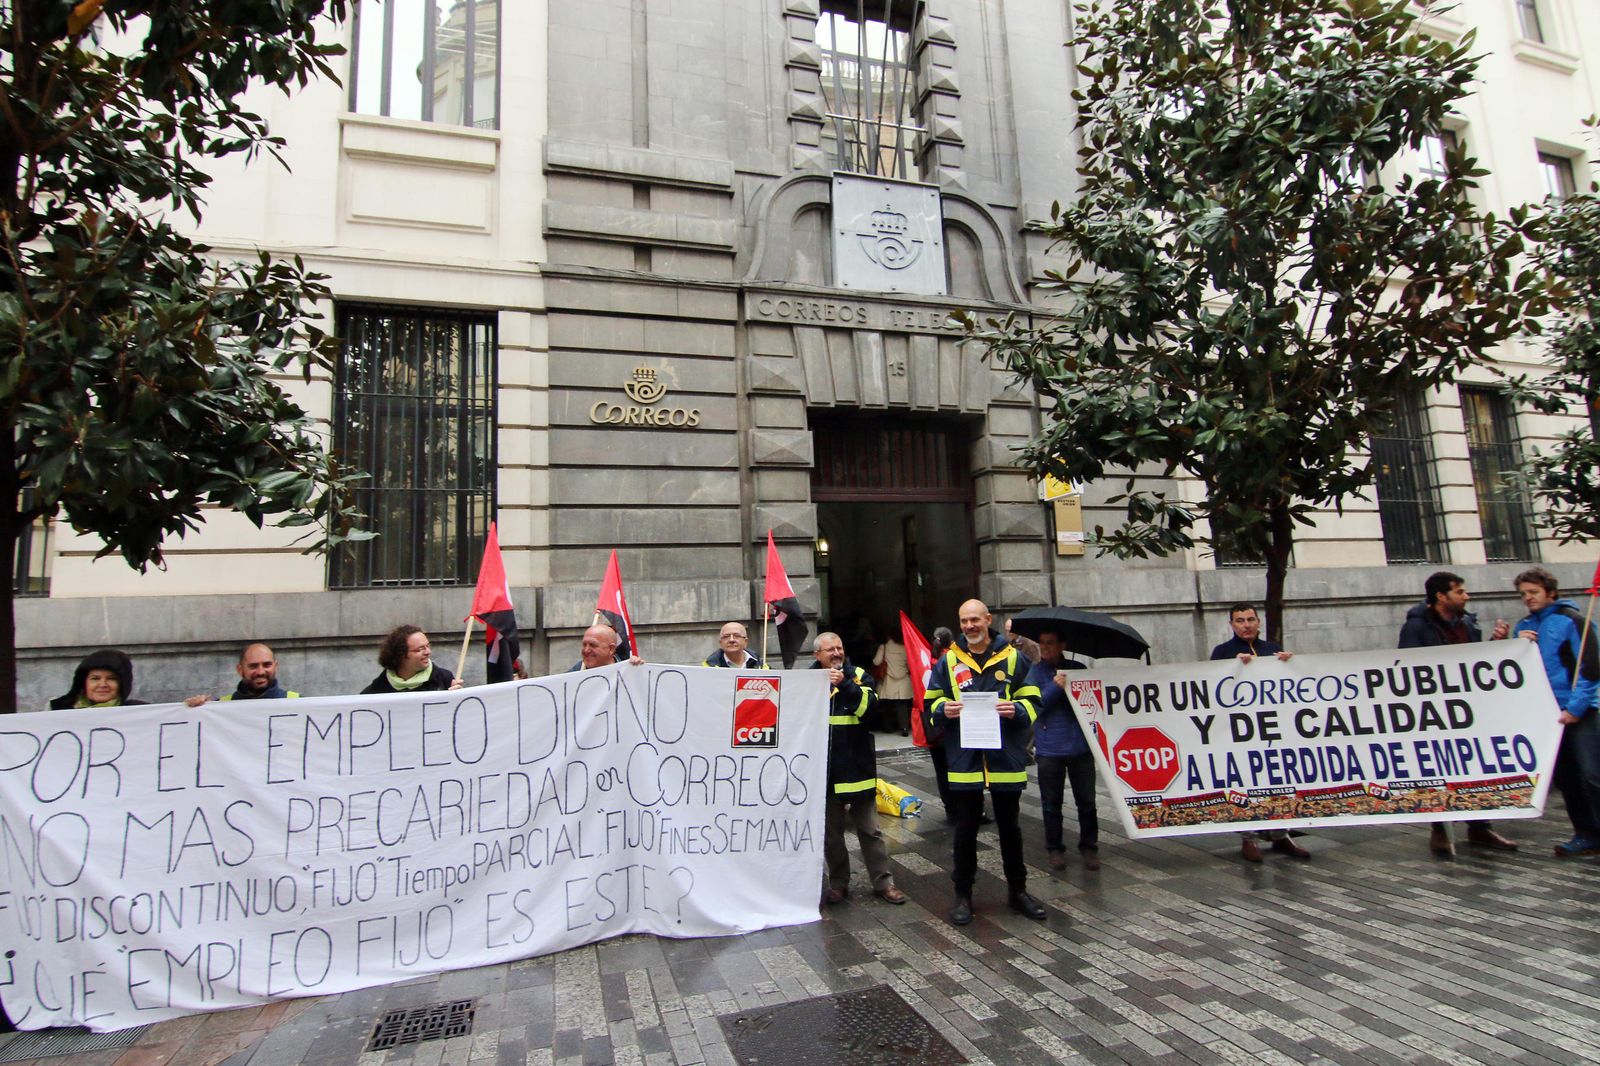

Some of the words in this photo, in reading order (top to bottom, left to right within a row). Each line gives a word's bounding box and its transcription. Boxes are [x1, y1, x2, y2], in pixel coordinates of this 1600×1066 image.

[758, 299, 867, 325] CORREOS
[889, 361, 905, 377] 15
[589, 401, 701, 428] CORREOS
[959, 679, 973, 689] CGT
[1071, 680, 1102, 692] SEVILLA
[1105, 683, 1162, 716] POR
[1169, 680, 1211, 712] UN
[1214, 673, 1359, 709] CORREOS
[1364, 659, 1525, 698] PÚBLICO
[736, 726, 775, 744] CGT
[1190, 714, 1216, 745] Y
[1229, 710, 1283, 743] DE
[1294, 698, 1474, 739] CALIDAD
[0, 727, 126, 804] POR
[157, 721, 225, 792] EL
[266, 696, 489, 785] EMPLEO
[516, 669, 689, 766] DIGNO
[1117, 746, 1175, 773] STOP
[1186, 754, 1205, 791] A
[1208, 750, 1244, 789] LA
[1369, 741, 1410, 780] DE
[1413, 733, 1538, 778] EMPLEO
[1229, 793, 1247, 805] CGT
[1370, 785, 1388, 797] CGT
[0, 811, 91, 889] NO
[119, 799, 256, 880] MAS
[285, 759, 590, 860] PRECARIEDAD
[595, 766, 624, 792] en
[627, 742, 809, 808] CORREOS
[713, 812, 814, 855] SEMANA
[485, 889, 535, 950] ES
